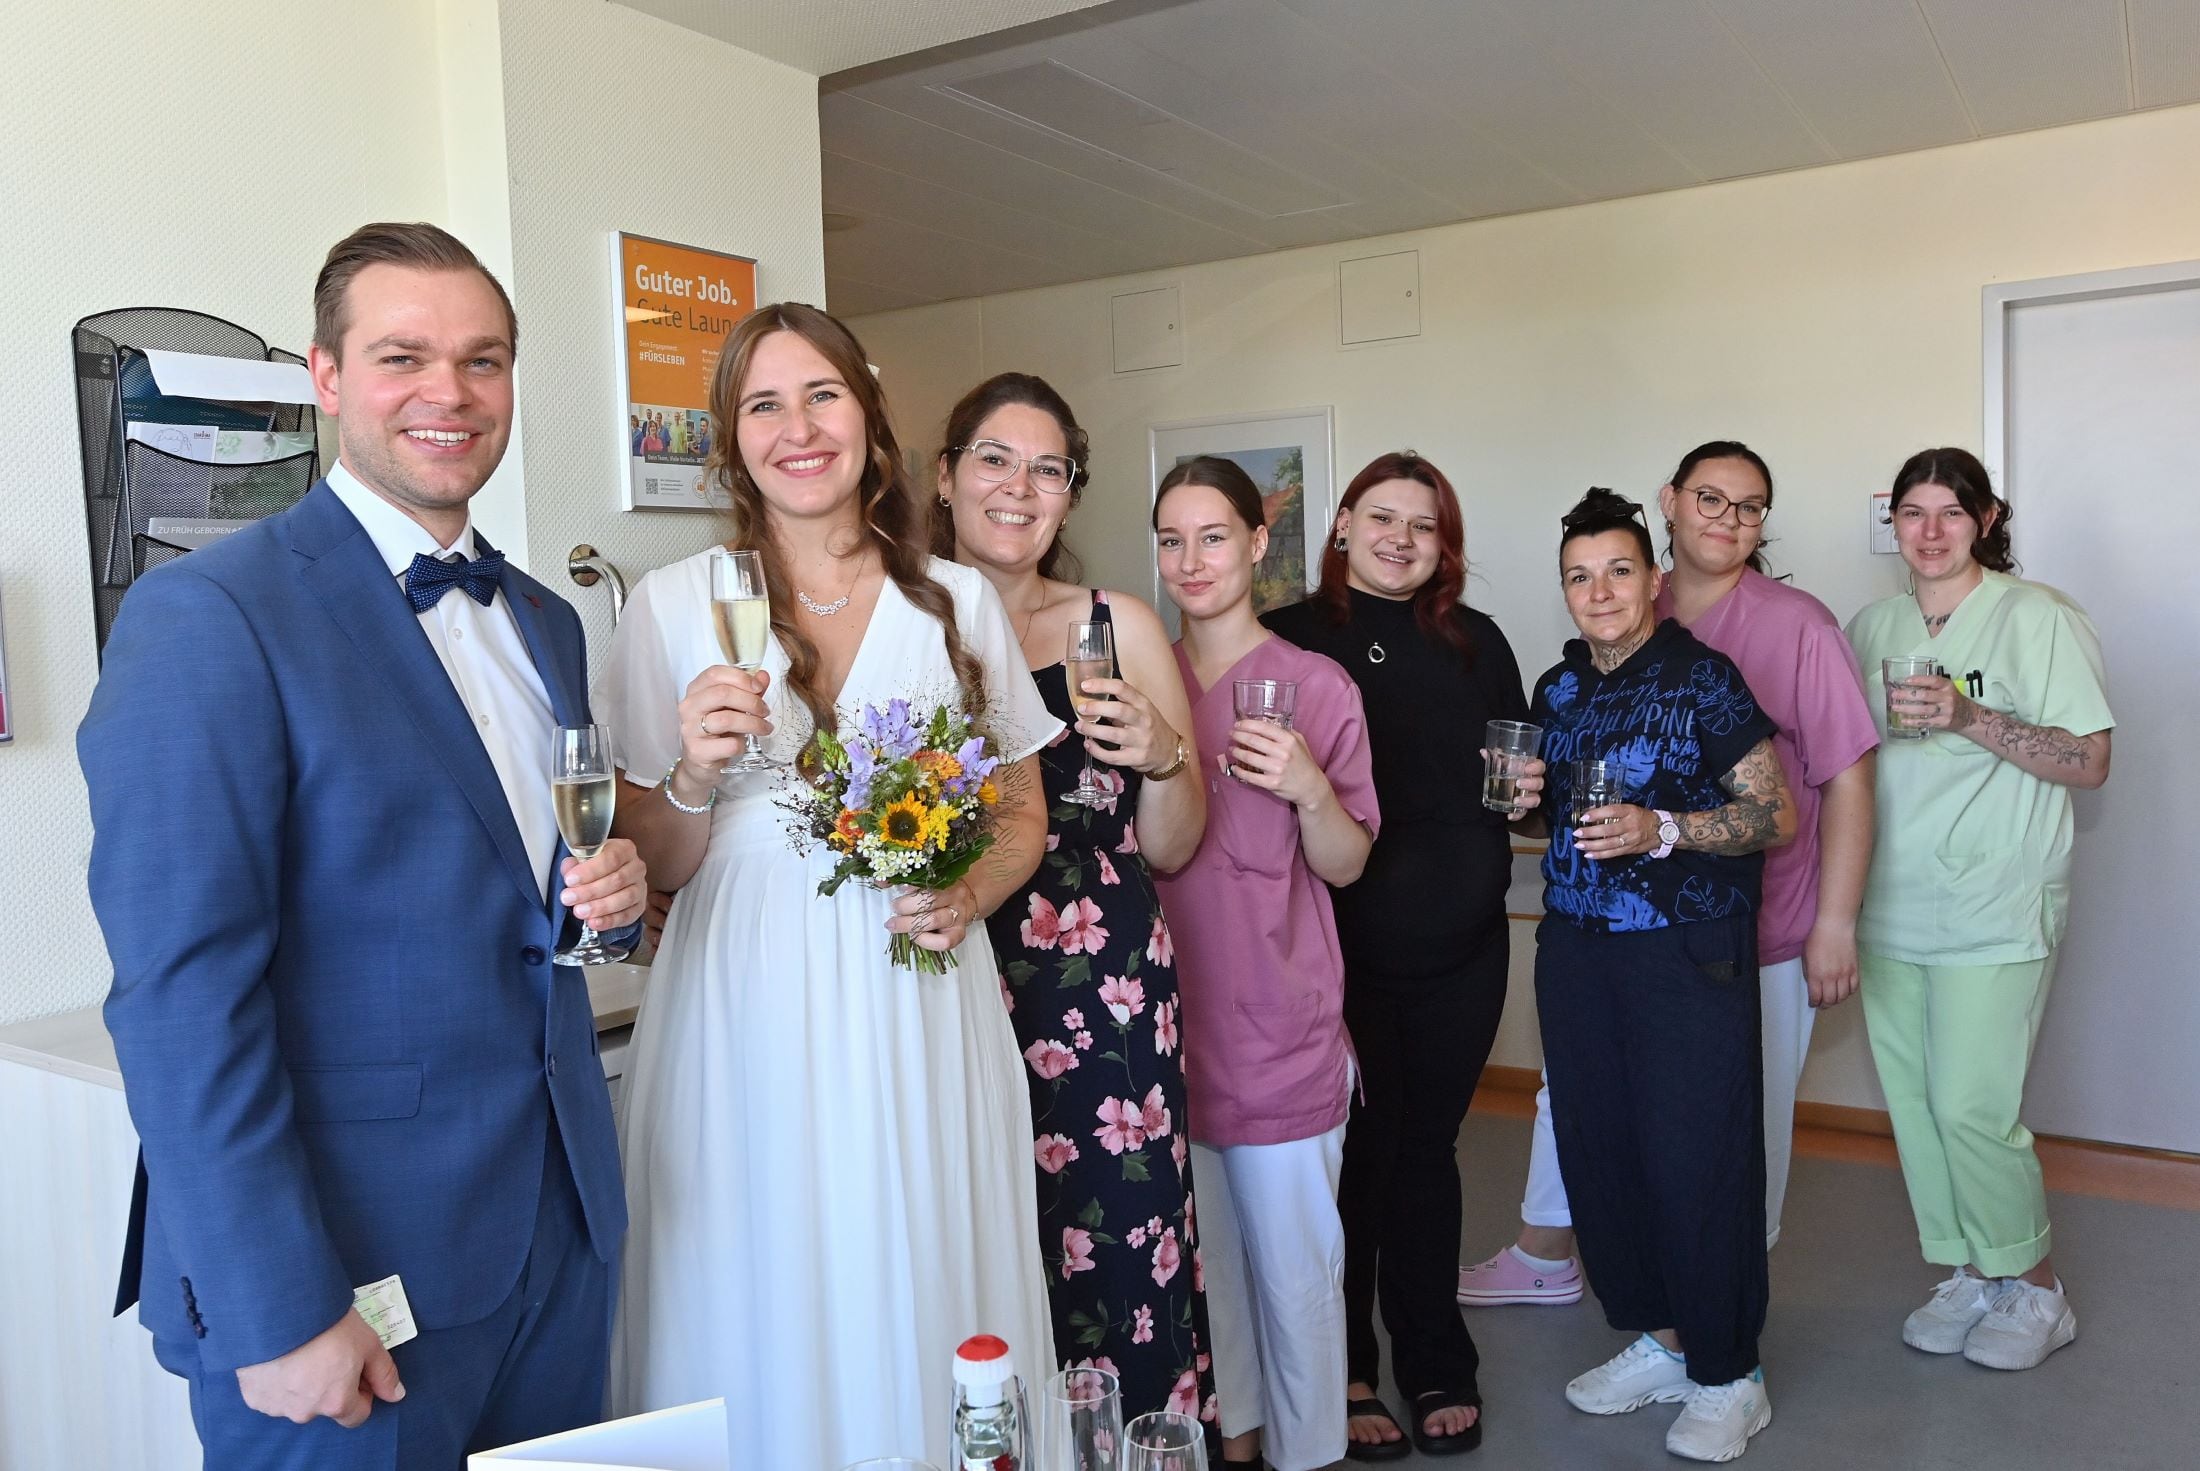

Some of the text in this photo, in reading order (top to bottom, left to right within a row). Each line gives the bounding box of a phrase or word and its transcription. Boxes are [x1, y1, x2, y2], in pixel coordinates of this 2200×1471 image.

[636, 264, 737, 306] Guter Job.
[637, 298, 738, 335] Gute Laun
[639, 349, 685, 366] #FÜRSLEBEN
[158, 526, 170, 534] ZU
[171, 525, 193, 534] FRÜH
[194, 526, 232, 535] GEBOREN
[1662, 752, 1701, 776] TICKET
